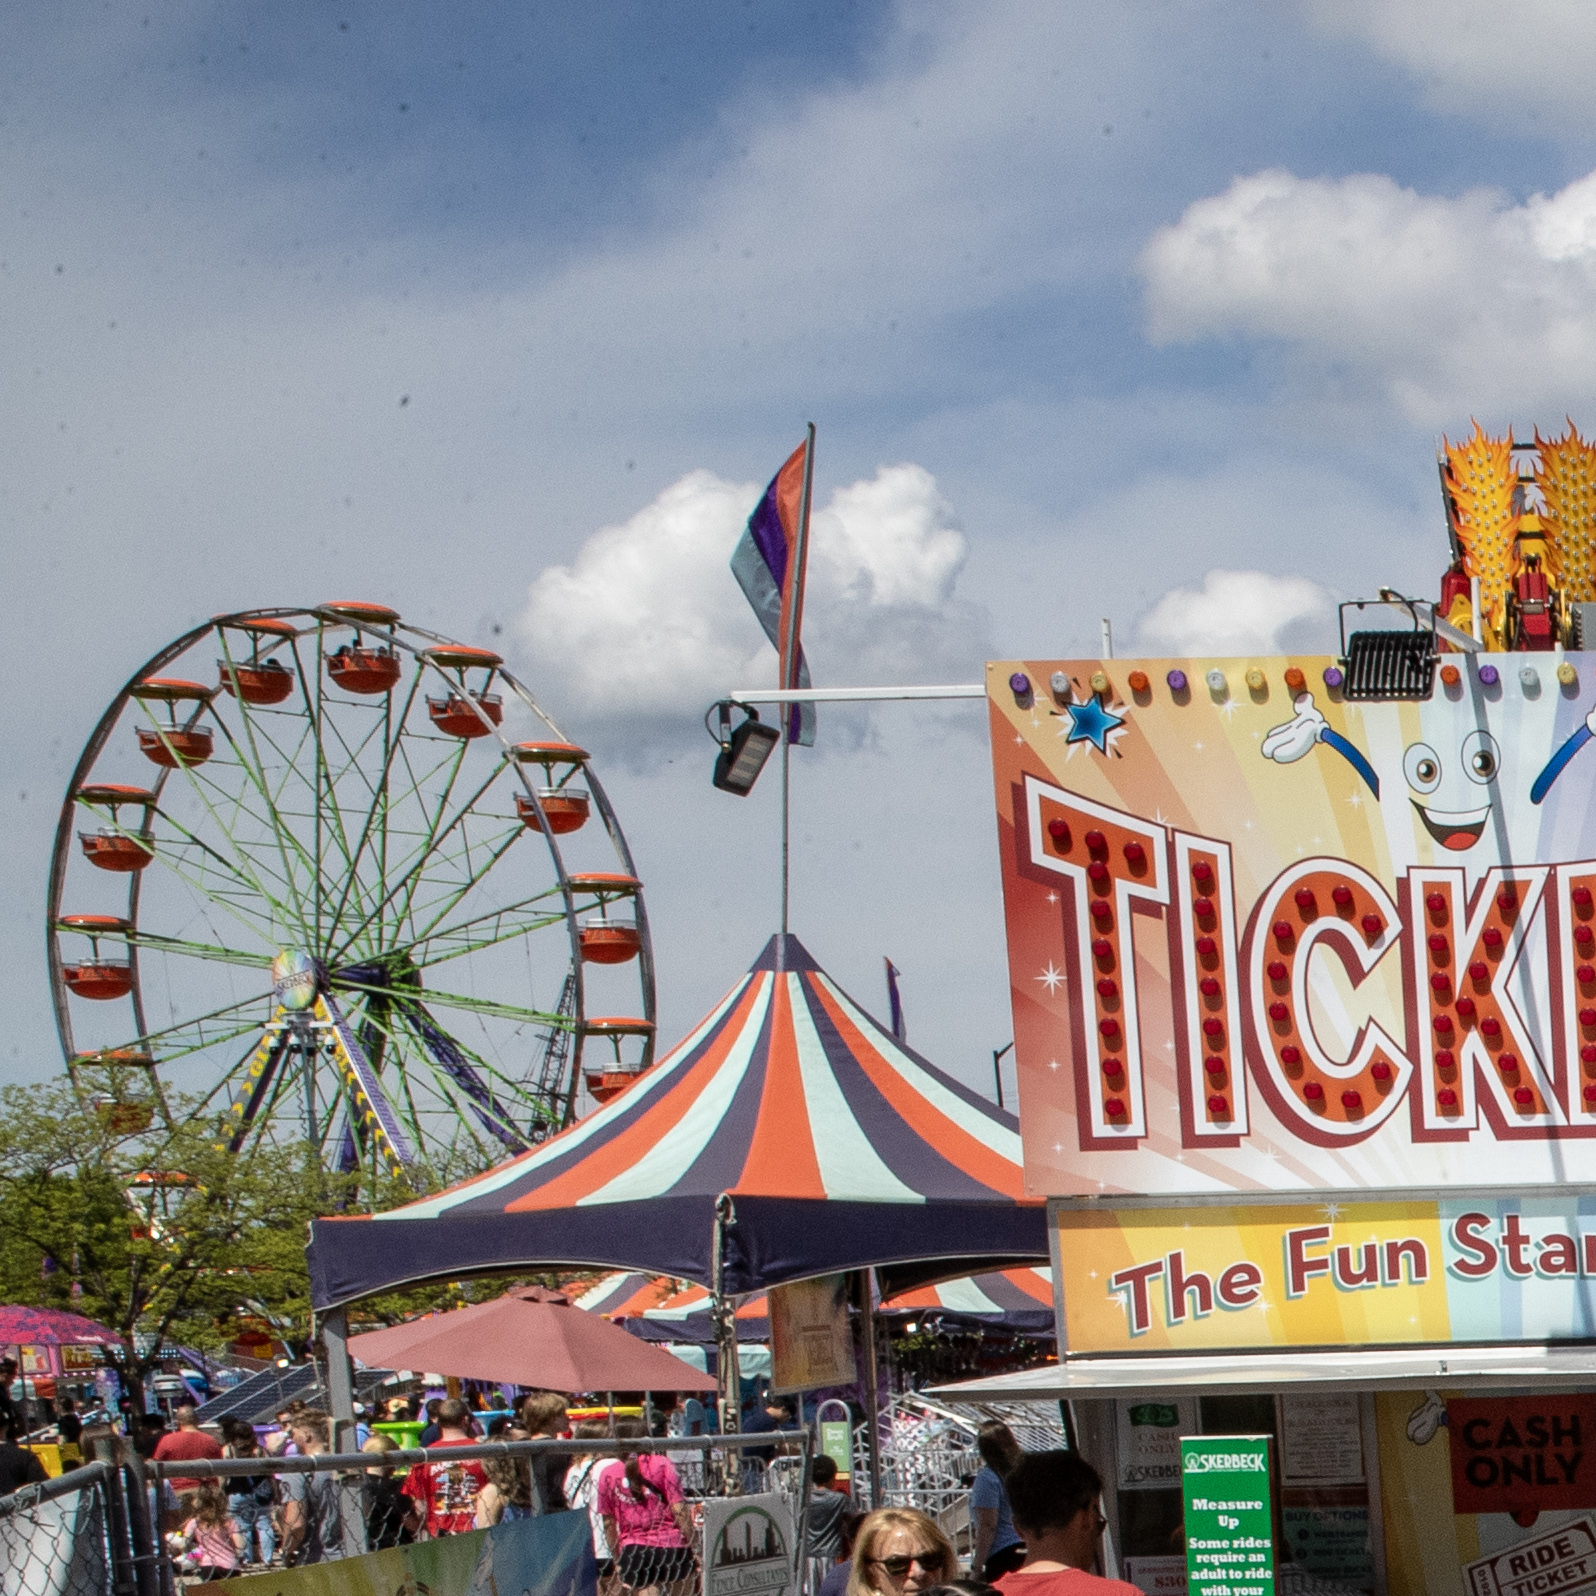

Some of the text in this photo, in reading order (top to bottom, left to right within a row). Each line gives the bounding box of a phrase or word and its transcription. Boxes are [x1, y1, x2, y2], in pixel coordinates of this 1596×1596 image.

[1111, 1252, 1261, 1335] The
[1285, 1222, 1429, 1301] Fun
[1462, 1414, 1583, 1450] CASH
[1200, 1453, 1265, 1472] SKERBECK
[1465, 1452, 1585, 1489] ONLY
[1136, 1465, 1182, 1480] SKERBE
[1191, 1498, 1264, 1511] Measure
[1217, 1514, 1241, 1531] Up
[1188, 1536, 1272, 1550] Some rides
[1195, 1552, 1266, 1567] require an
[1510, 1537, 1576, 1578] RIDE
[1190, 1567, 1274, 1581] adult to ride
